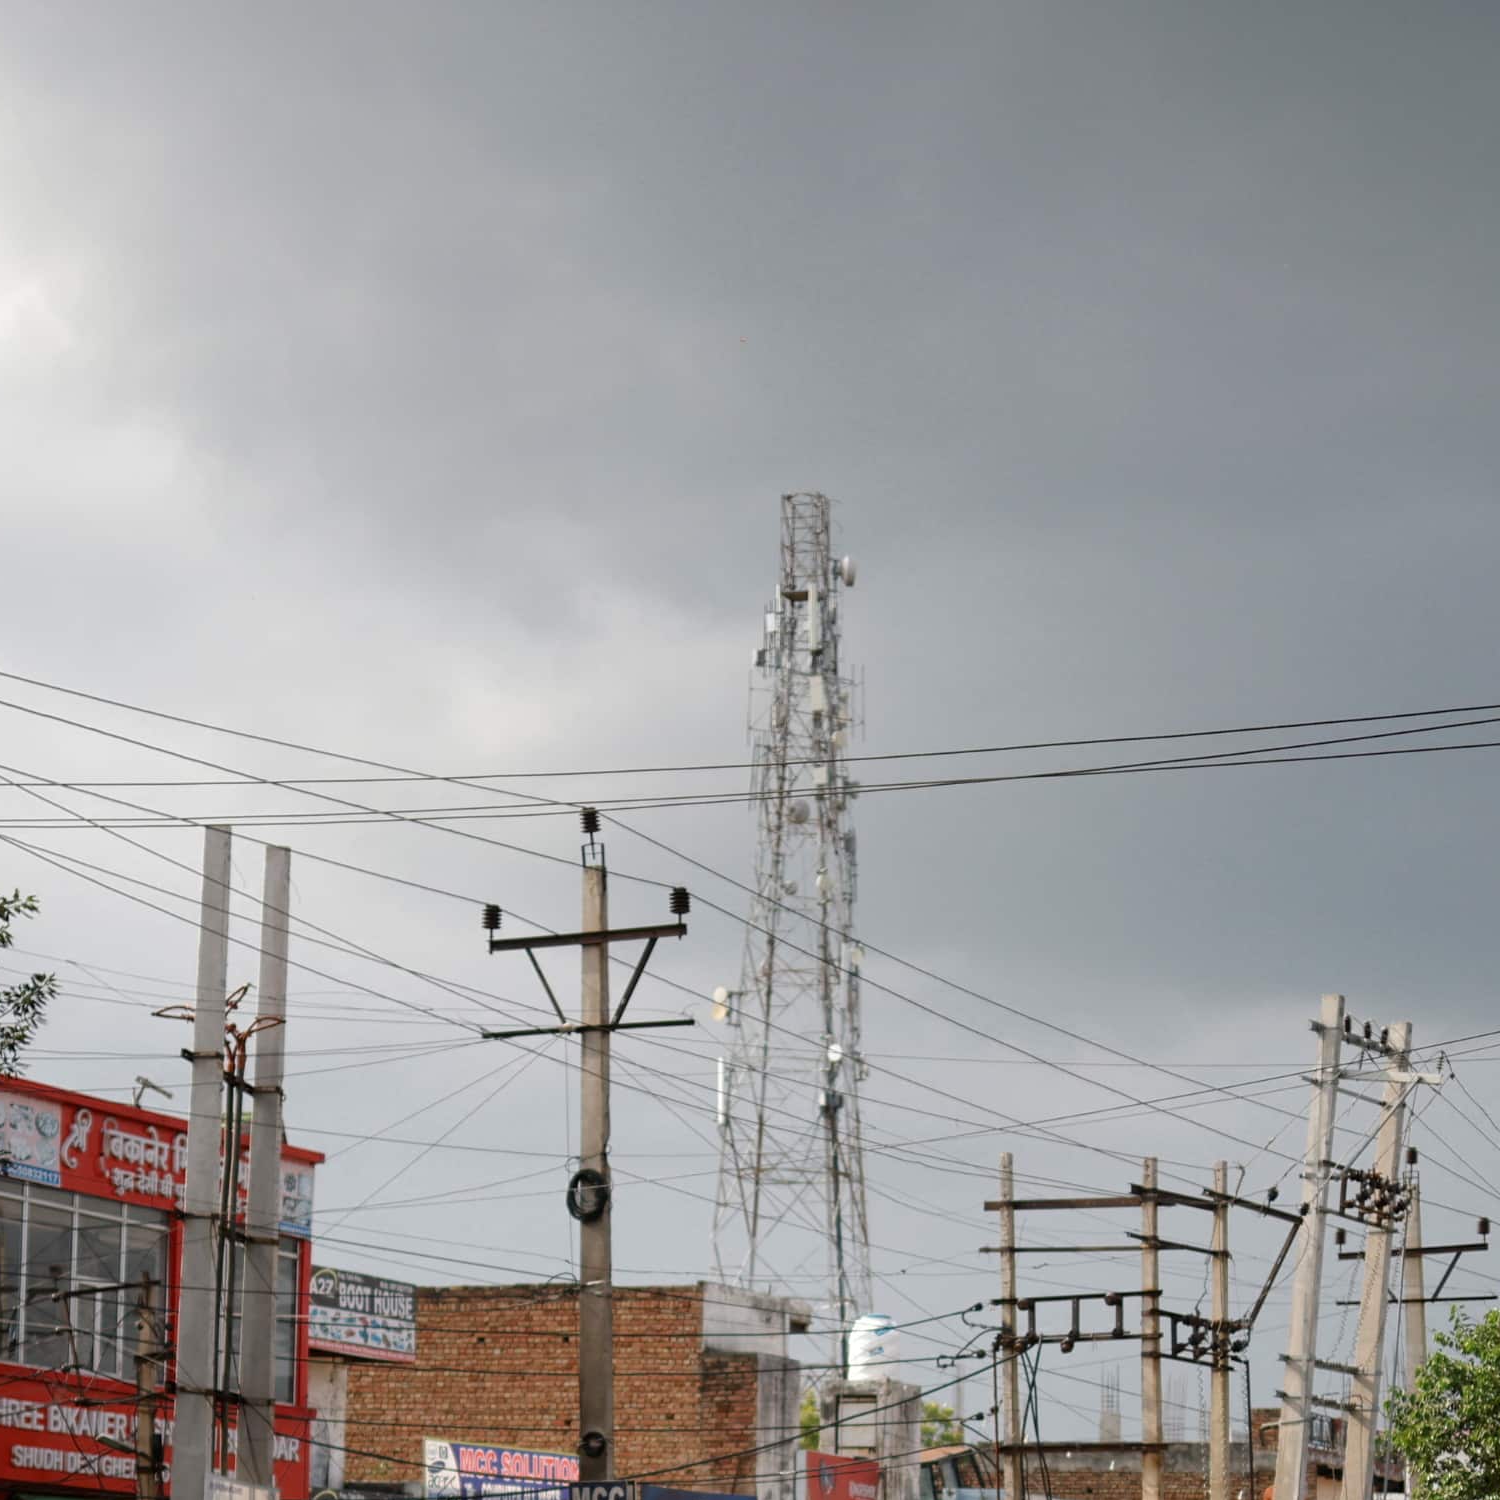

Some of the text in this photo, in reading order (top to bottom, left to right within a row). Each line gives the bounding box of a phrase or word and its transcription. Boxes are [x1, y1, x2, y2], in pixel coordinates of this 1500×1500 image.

[339, 1282, 372, 1312] BOOT
[373, 1288, 414, 1320] HOUSE
[11, 1445, 63, 1471] SHUDH
